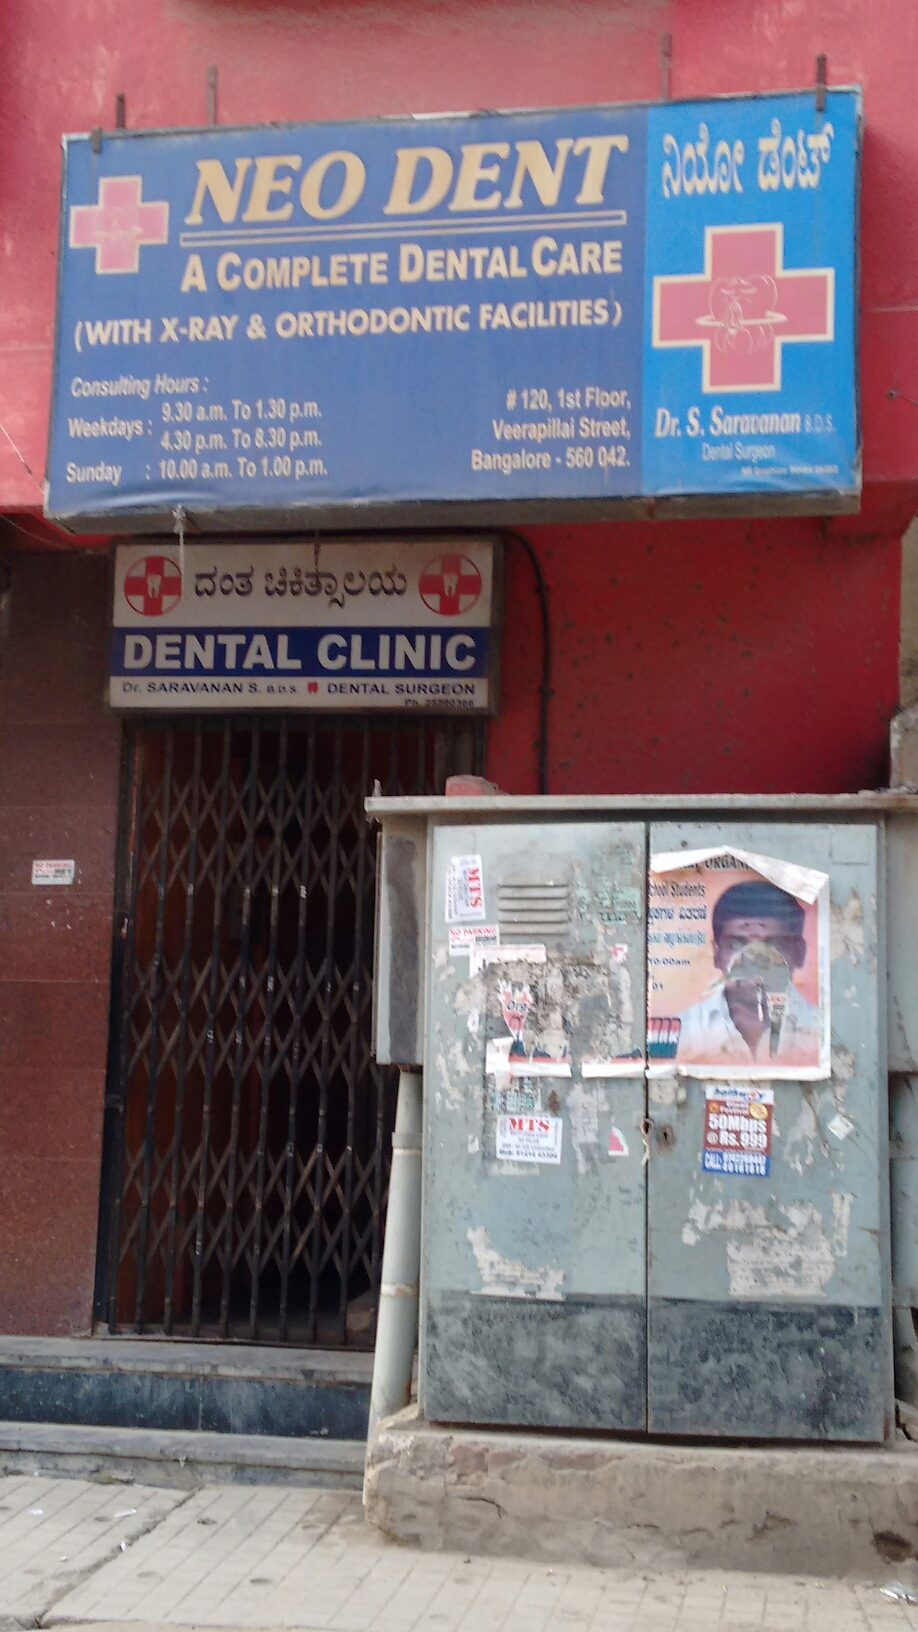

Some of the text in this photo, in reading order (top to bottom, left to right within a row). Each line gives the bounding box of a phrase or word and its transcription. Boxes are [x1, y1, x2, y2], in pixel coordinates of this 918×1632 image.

[184, 133, 629, 226] NEO DENT
[180, 236, 622, 292] A COMPLETE DENTAL CARE
[74, 318, 151, 352] (WITH
[159, 313, 239, 343] X-RAY
[246, 312, 267, 339] &
[275, 303, 470, 338] ORTHODONTIC
[70, 375, 151, 400] Consulting
[154, 373, 200, 395] Hours
[557, 387, 582, 409] 1st
[585, 385, 632, 411] Floor,
[161, 398, 322, 422] 9.30 a.m. To 1.30 p.m.
[654, 407, 682, 438] Dr.
[686, 405, 705, 438] S.
[709, 404, 801, 437] Saravanan
[68, 416, 144, 441] Weekdays
[160, 427, 322, 455] 4.30 p.m. To 8.30 p.m.
[492, 415, 631, 443] Veerapillai Street,
[471, 448, 551, 475] Bangalore
[566, 446, 594, 469] 560
[598, 444, 631, 469] 042.
[702, 440, 776, 464] Dental Surgeon
[66, 460, 122, 487] Sunday
[159, 458, 198, 480] 10.00
[201, 459, 233, 479] a.m.
[236, 456, 256, 477] To
[261, 455, 292, 477] 1.00
[294, 456, 328, 480] p.m.
[194, 565, 255, 597] ದಂತ
[123, 633, 477, 671] DENTAL CLINIC
[122, 682, 142, 694] Dr.
[147, 682, 243, 694] SARAVANAN
[248, 683, 262, 694] S.
[327, 683, 389, 695] DENTAL
[395, 683, 475, 695] SURGEON
[468, 866, 483, 908] MTS
[509, 1116, 550, 1132] MTS
